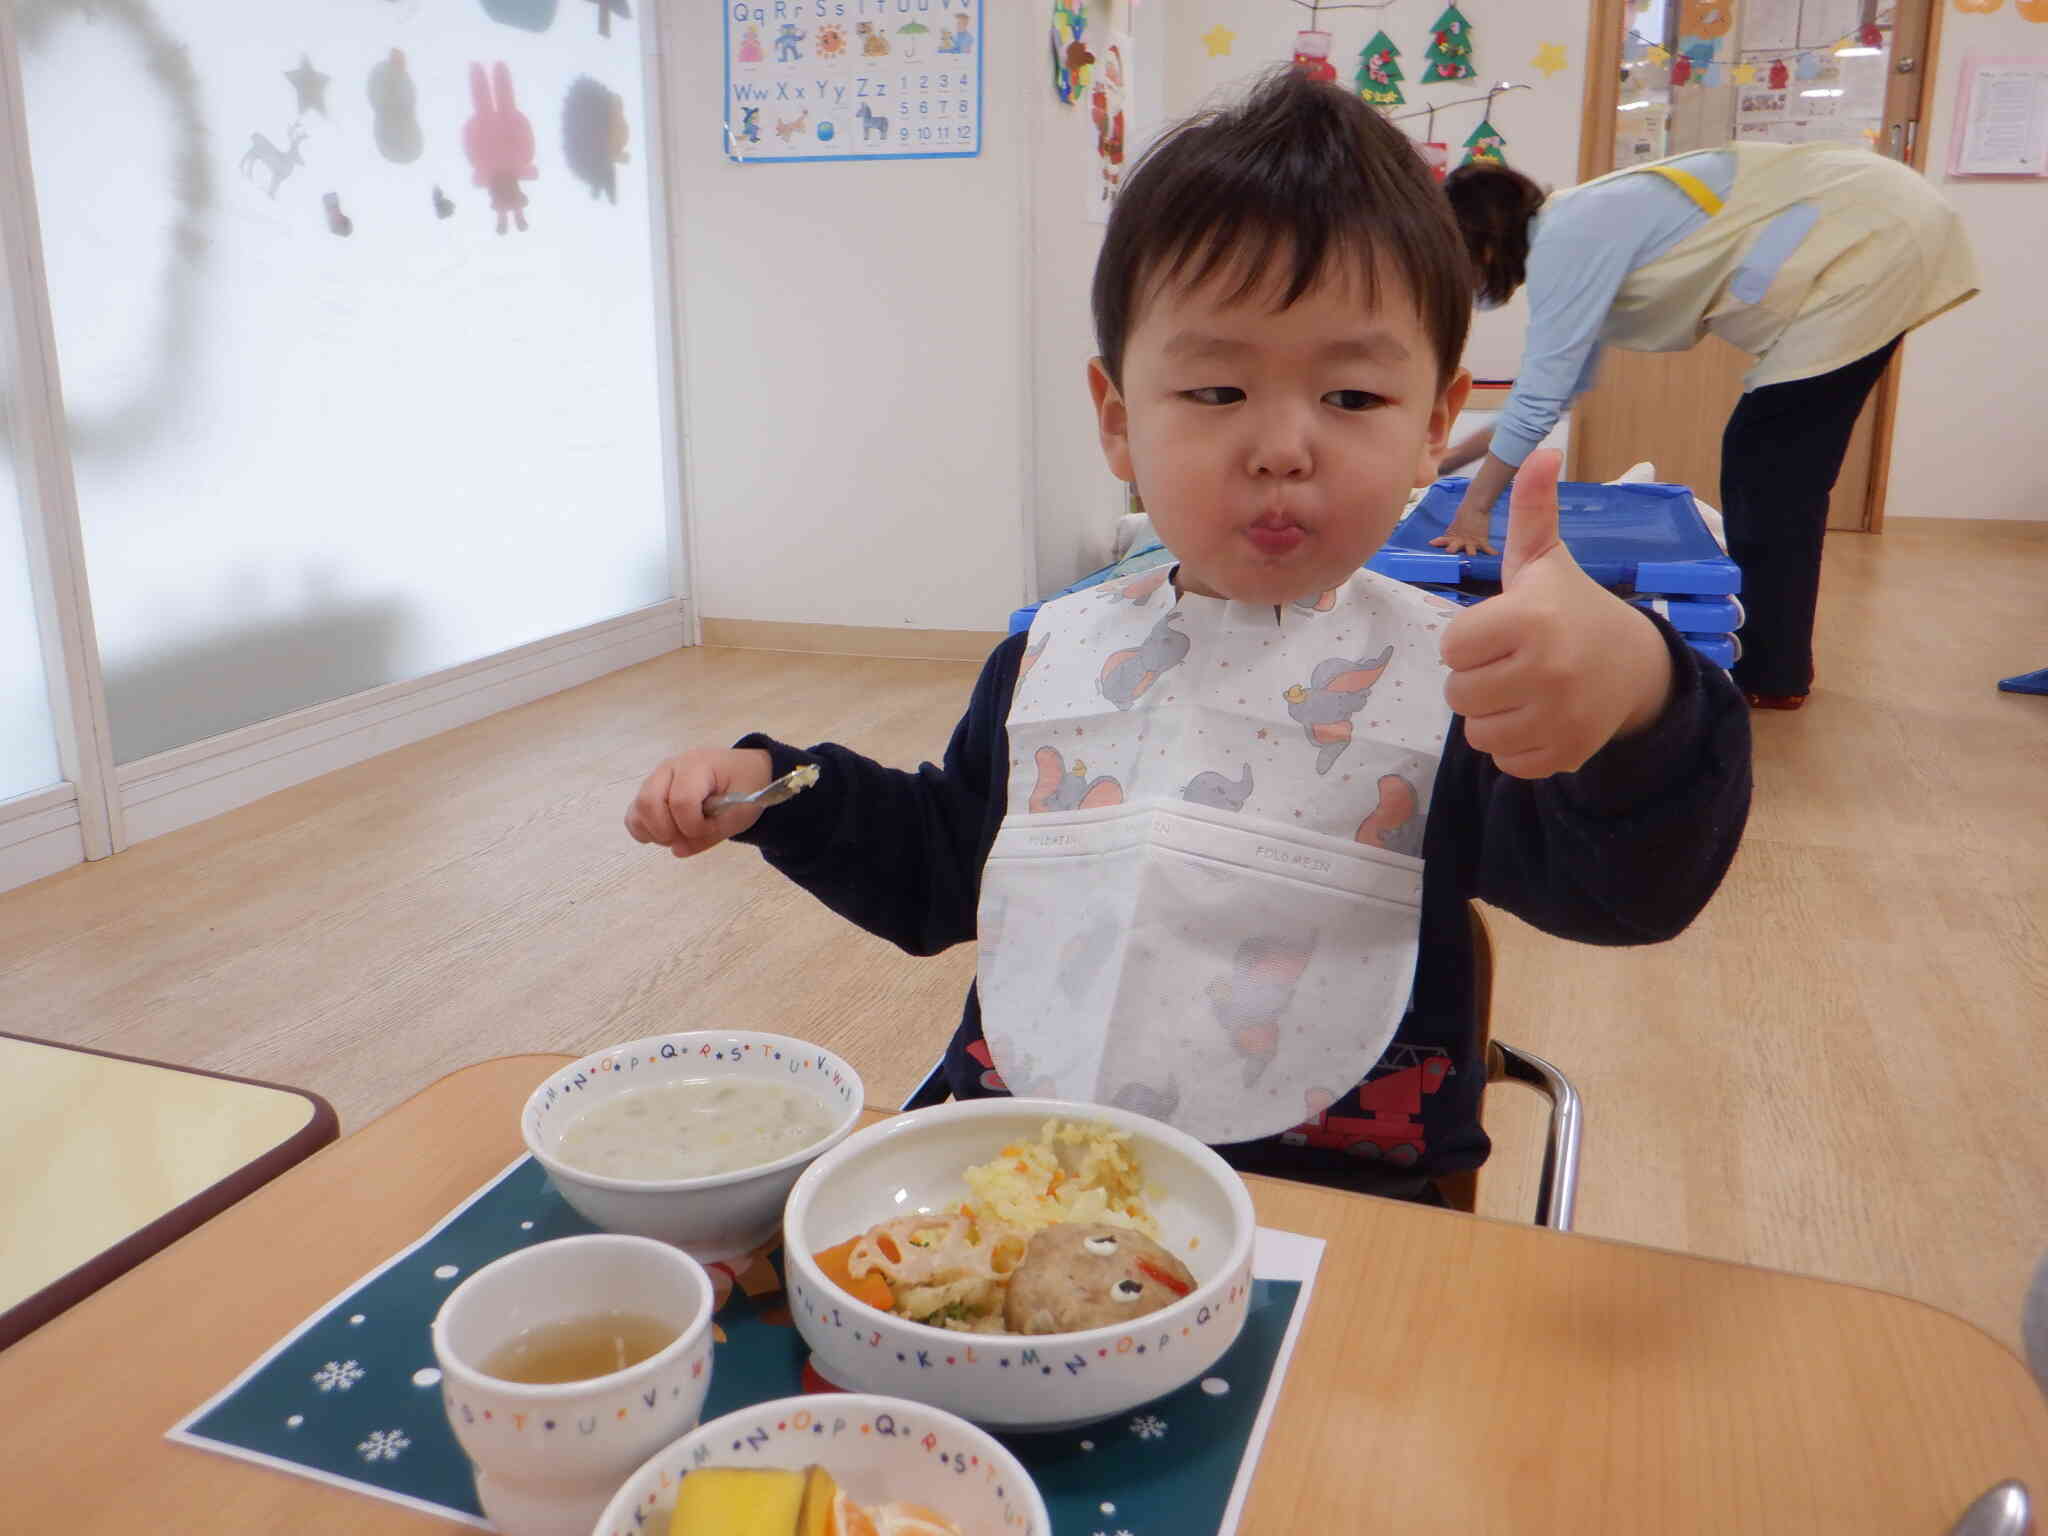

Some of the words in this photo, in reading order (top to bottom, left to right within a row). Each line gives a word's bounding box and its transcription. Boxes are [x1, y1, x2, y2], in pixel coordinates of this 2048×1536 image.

[919, 75, 929, 88] 2
[938, 74, 949, 88] 3
[959, 73, 968, 86] 4
[899, 102, 909, 114] 5
[937, 100, 948, 113] 7
[899, 127, 909, 141] 9
[917, 126, 932, 139] 10
[937, 126, 950, 139] 11
[956, 124, 971, 139] 12
[574, 1073, 588, 1090] N
[630, 1057, 640, 1071] P
[660, 1044, 678, 1058] Q
[731, 1049, 743, 1062] S
[761, 1044, 774, 1057] T
[789, 1059, 800, 1074] U
[916, 1350, 933, 1368] K
[965, 1346, 977, 1364] L
[1020, 1349, 1041, 1366] M
[1065, 1354, 1088, 1376] N
[1116, 1336, 1134, 1354] O
[1197, 1306, 1211, 1325] Q
[513, 1414, 527, 1432] T
[578, 1416, 597, 1435] U
[642, 1388, 657, 1408] V
[747, 1427, 770, 1453] N
[792, 1410, 811, 1431] O
[832, 1421, 847, 1439] P
[874, 1414, 897, 1438] Q
[954, 1453, 967, 1474] S
